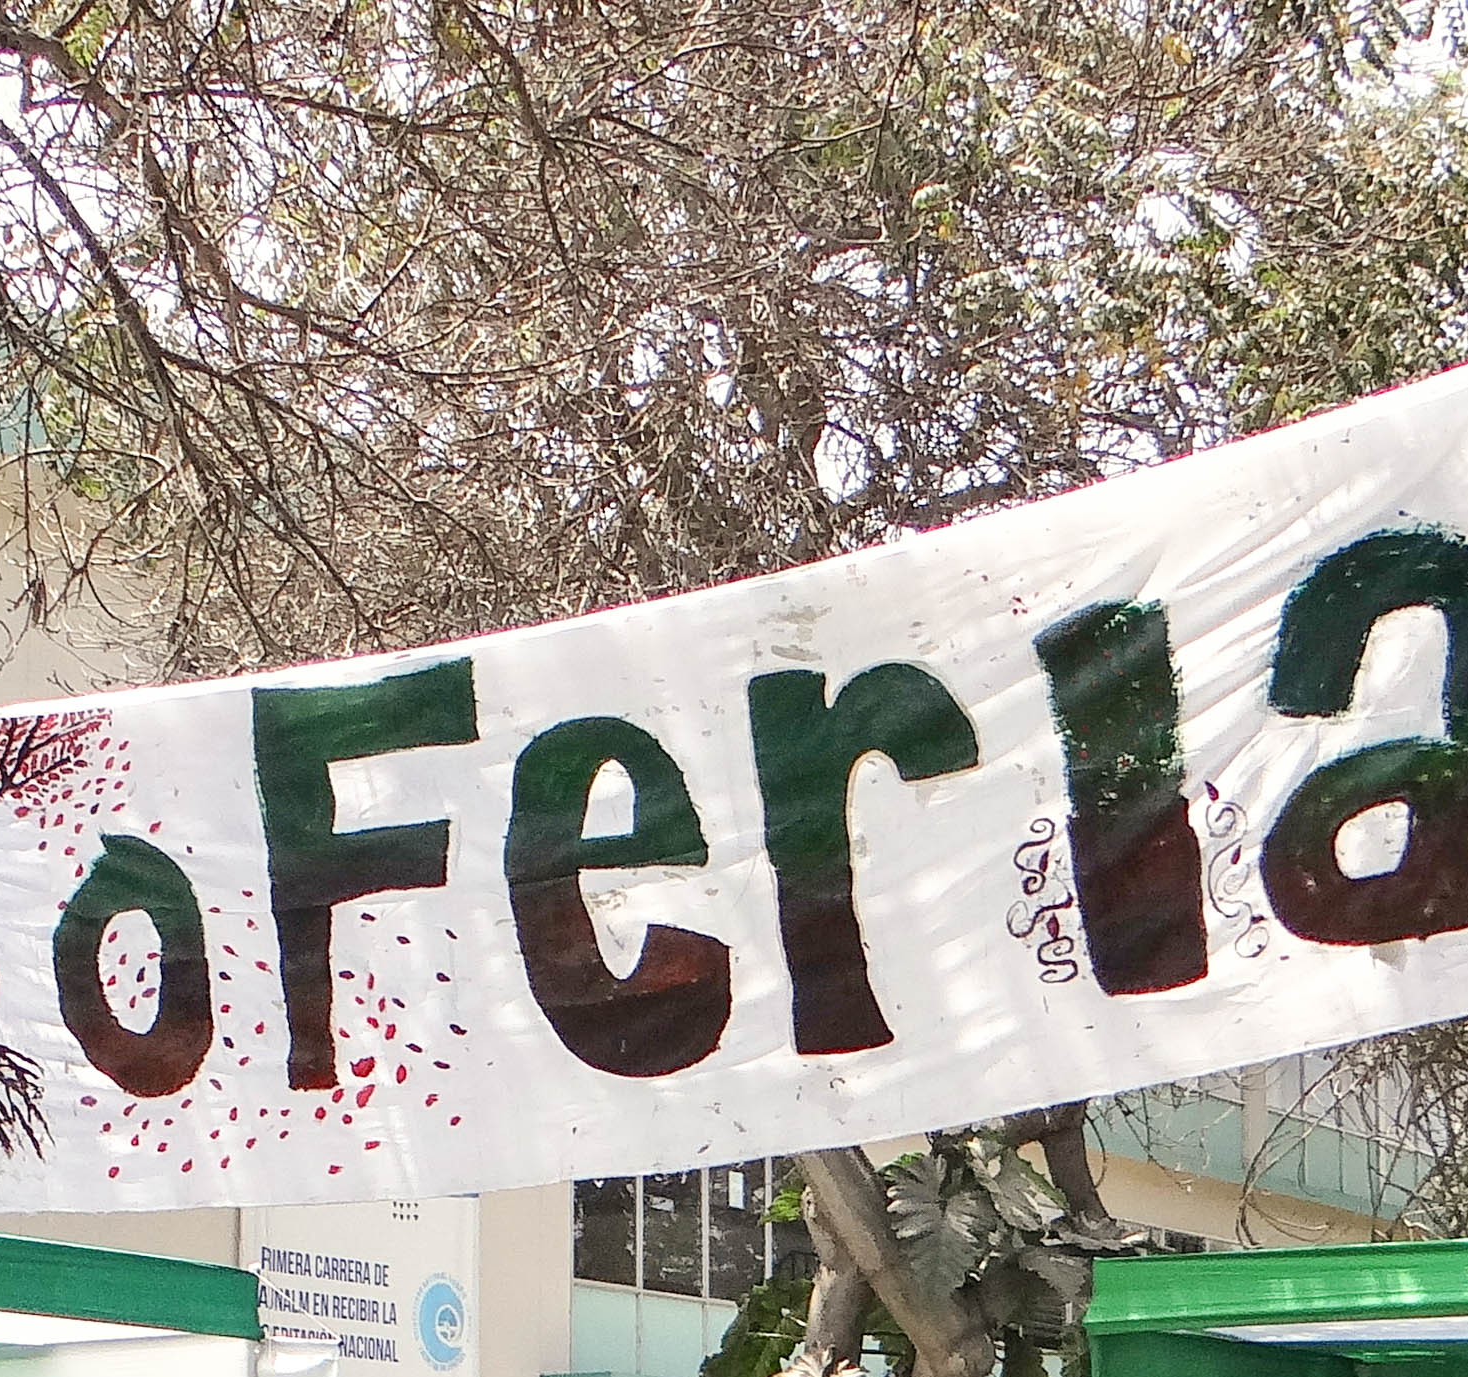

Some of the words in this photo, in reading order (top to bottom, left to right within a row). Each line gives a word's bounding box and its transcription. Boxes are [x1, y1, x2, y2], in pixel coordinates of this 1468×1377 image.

[315, 1254, 370, 1284] CARRERA
[374, 1263, 389, 1287] DE
[258, 1285, 268, 1309] A
[313, 1293, 328, 1317] EN
[333, 1295, 379, 1323] RECIBIR
[382, 1302, 397, 1325] LA
[339, 1334, 399, 1362] NACIONAL
